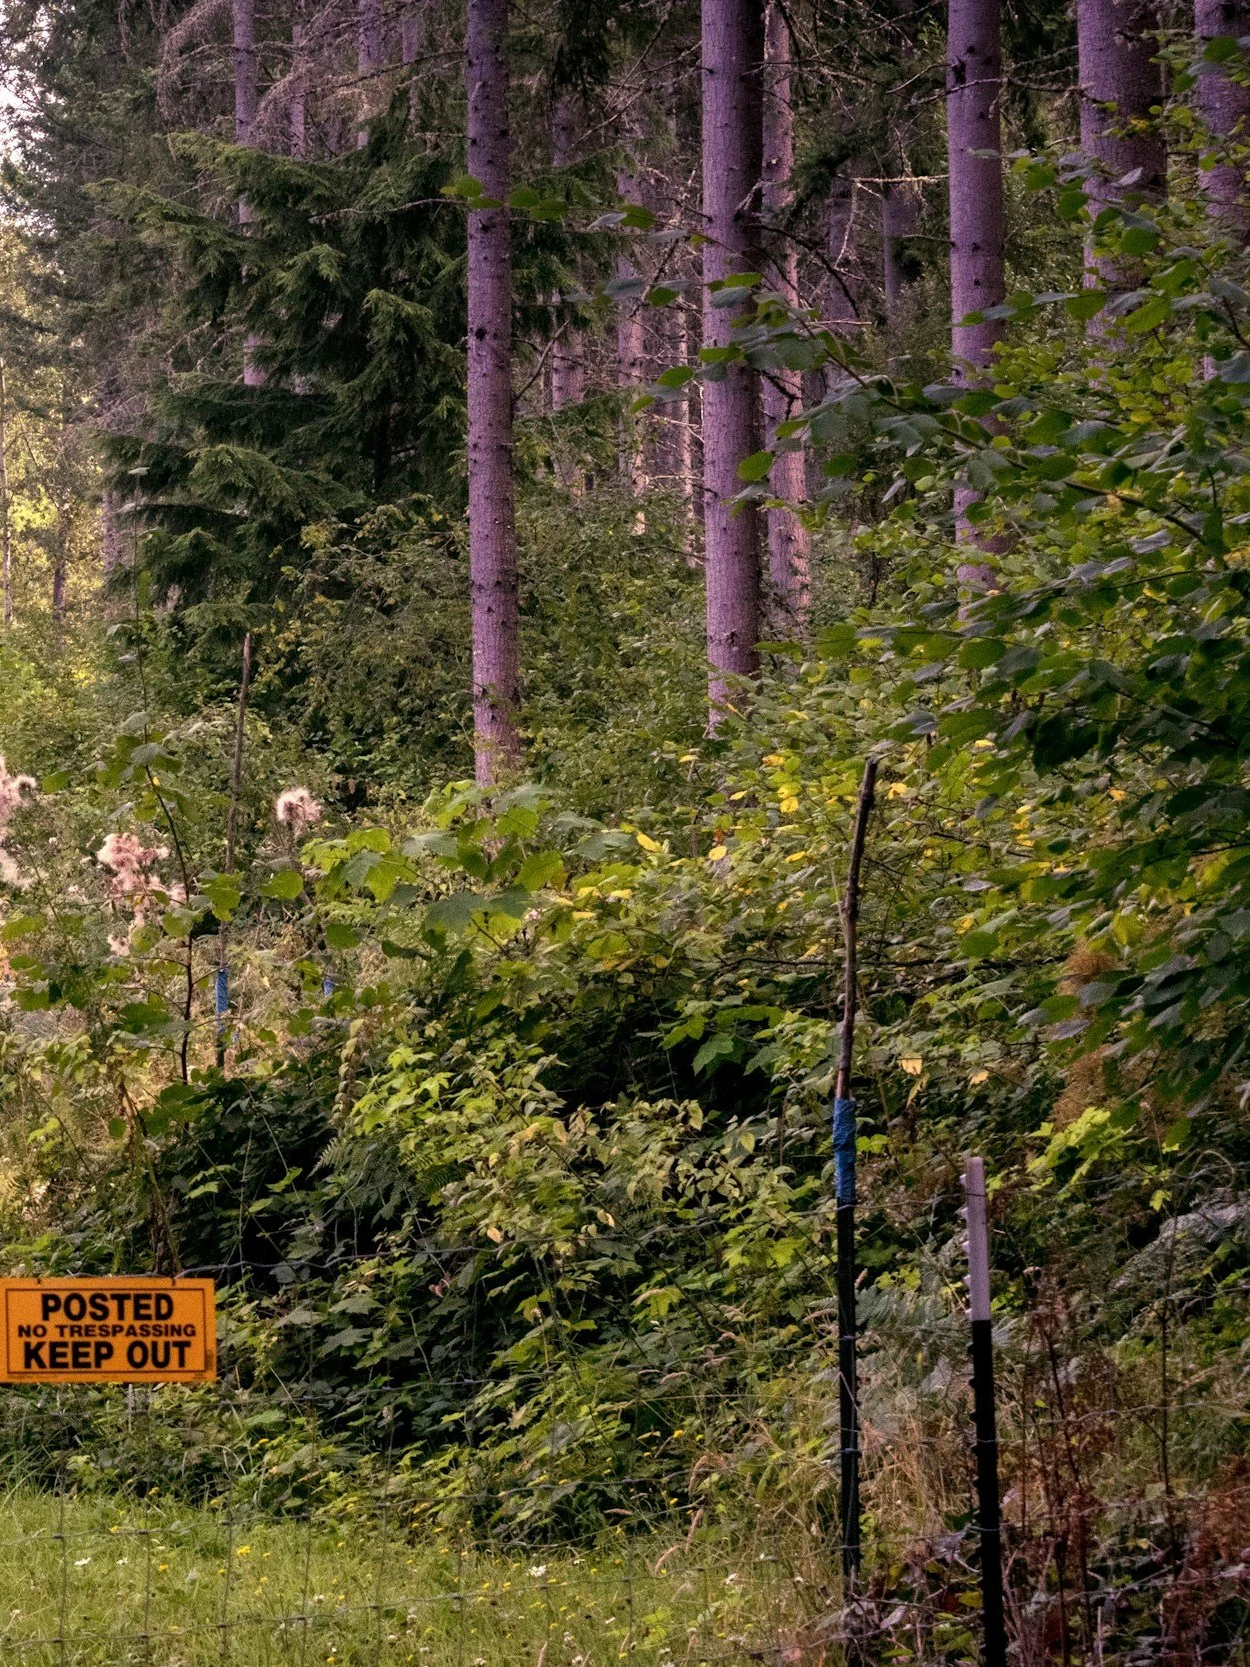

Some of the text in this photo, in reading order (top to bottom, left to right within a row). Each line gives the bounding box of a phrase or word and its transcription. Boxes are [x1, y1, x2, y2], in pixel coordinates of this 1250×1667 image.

[41, 1292, 174, 1321] POSTED
[18, 1324, 196, 1337] NO TRESPASSING
[24, 1340, 191, 1369] KEEP OUT
